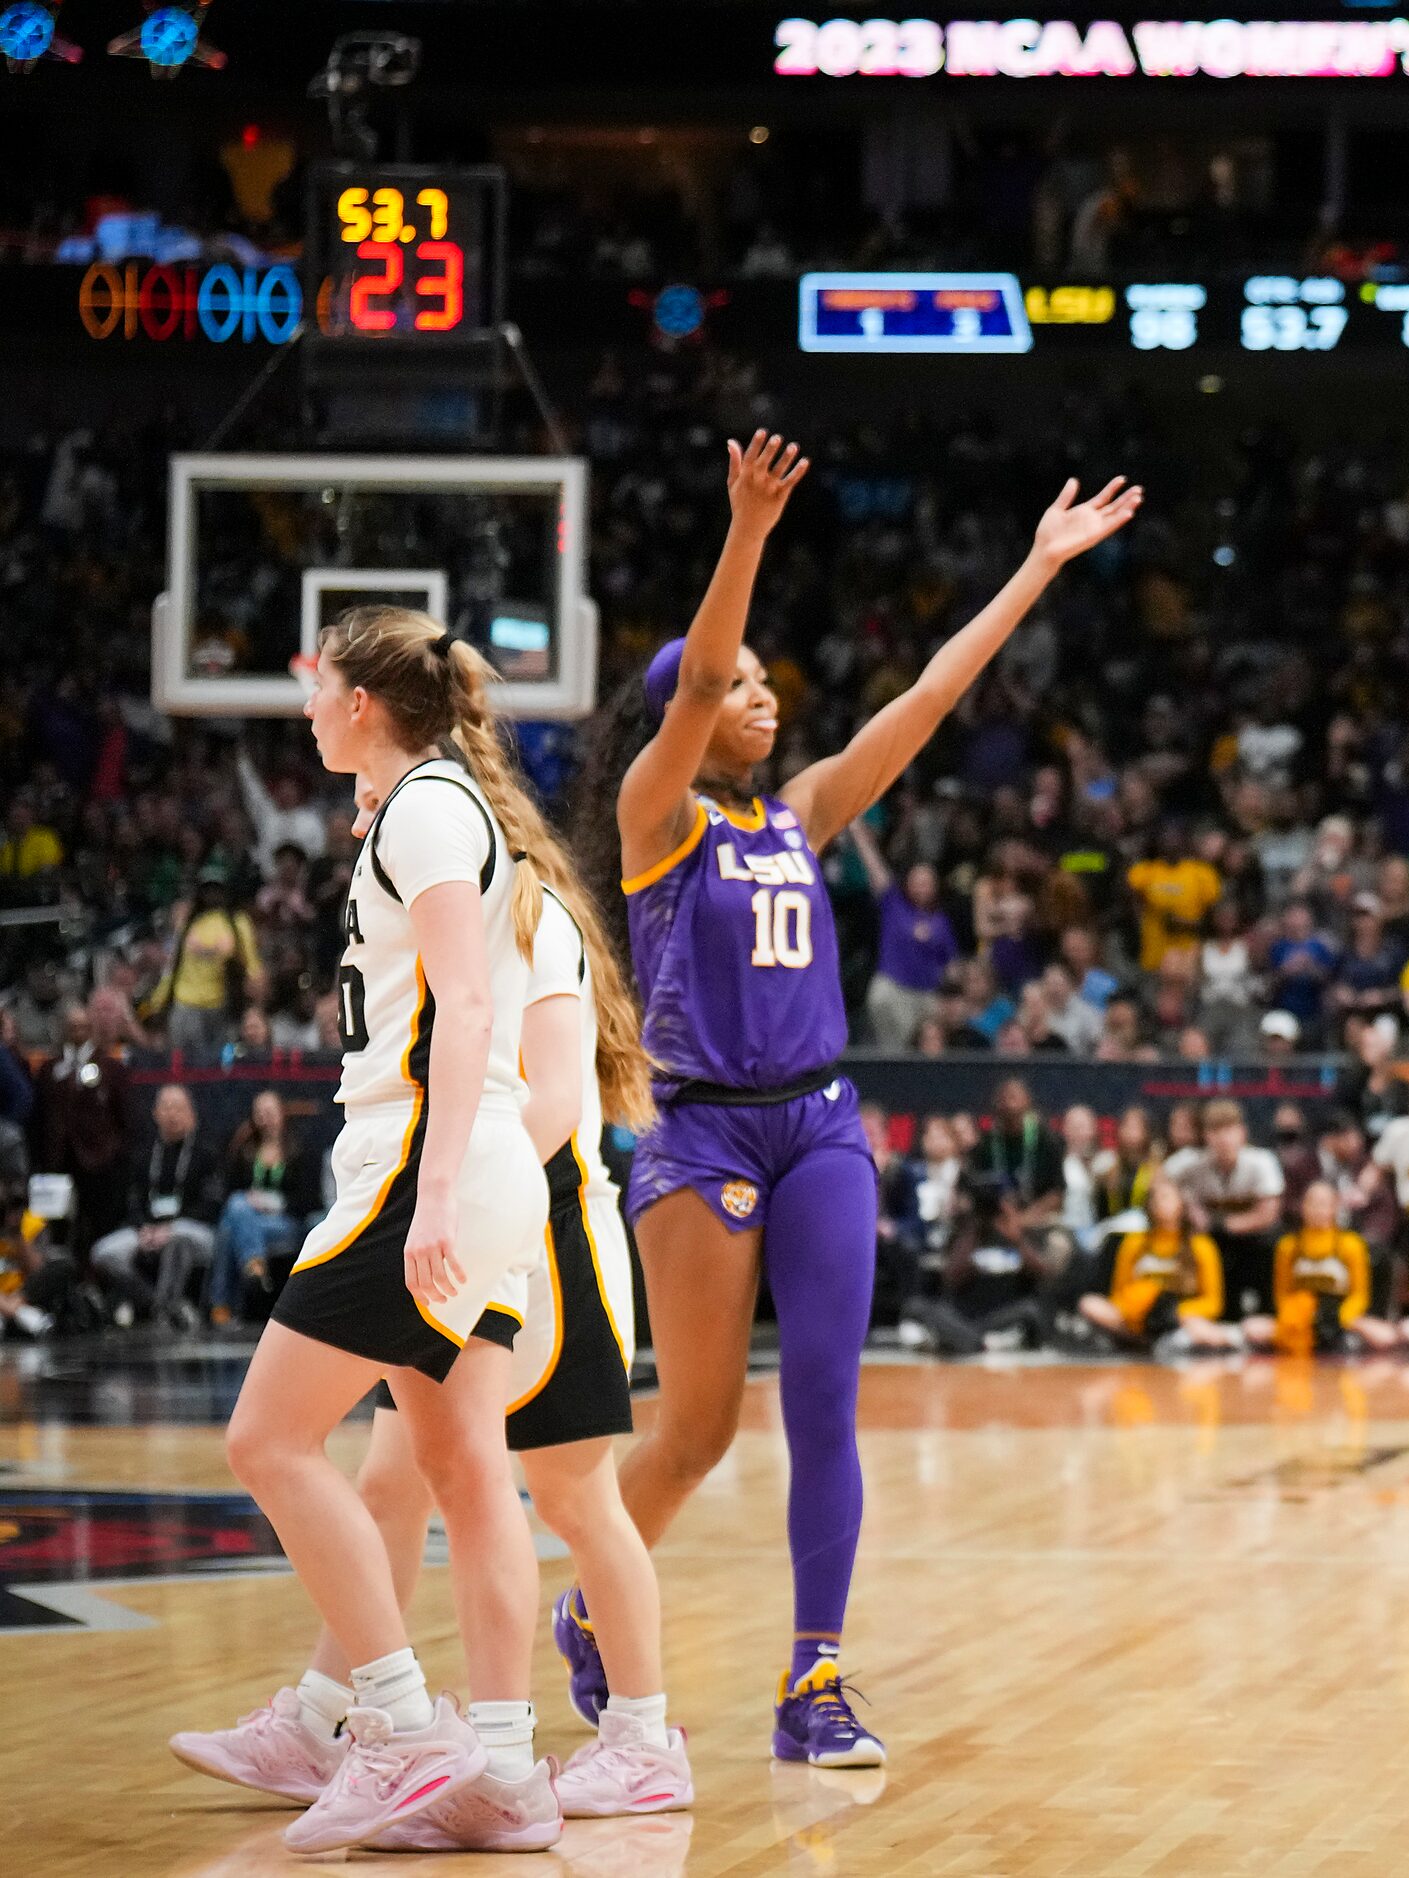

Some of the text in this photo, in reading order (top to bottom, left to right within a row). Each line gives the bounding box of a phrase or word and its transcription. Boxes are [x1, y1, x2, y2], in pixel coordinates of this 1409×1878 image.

[774, 18, 945, 77] 2023
[945, 18, 1136, 77] NCAA
[338, 187, 448, 243] 53.7
[350, 241, 464, 331] 23
[715, 841, 815, 886] LSU
[750, 889, 814, 969] 10
